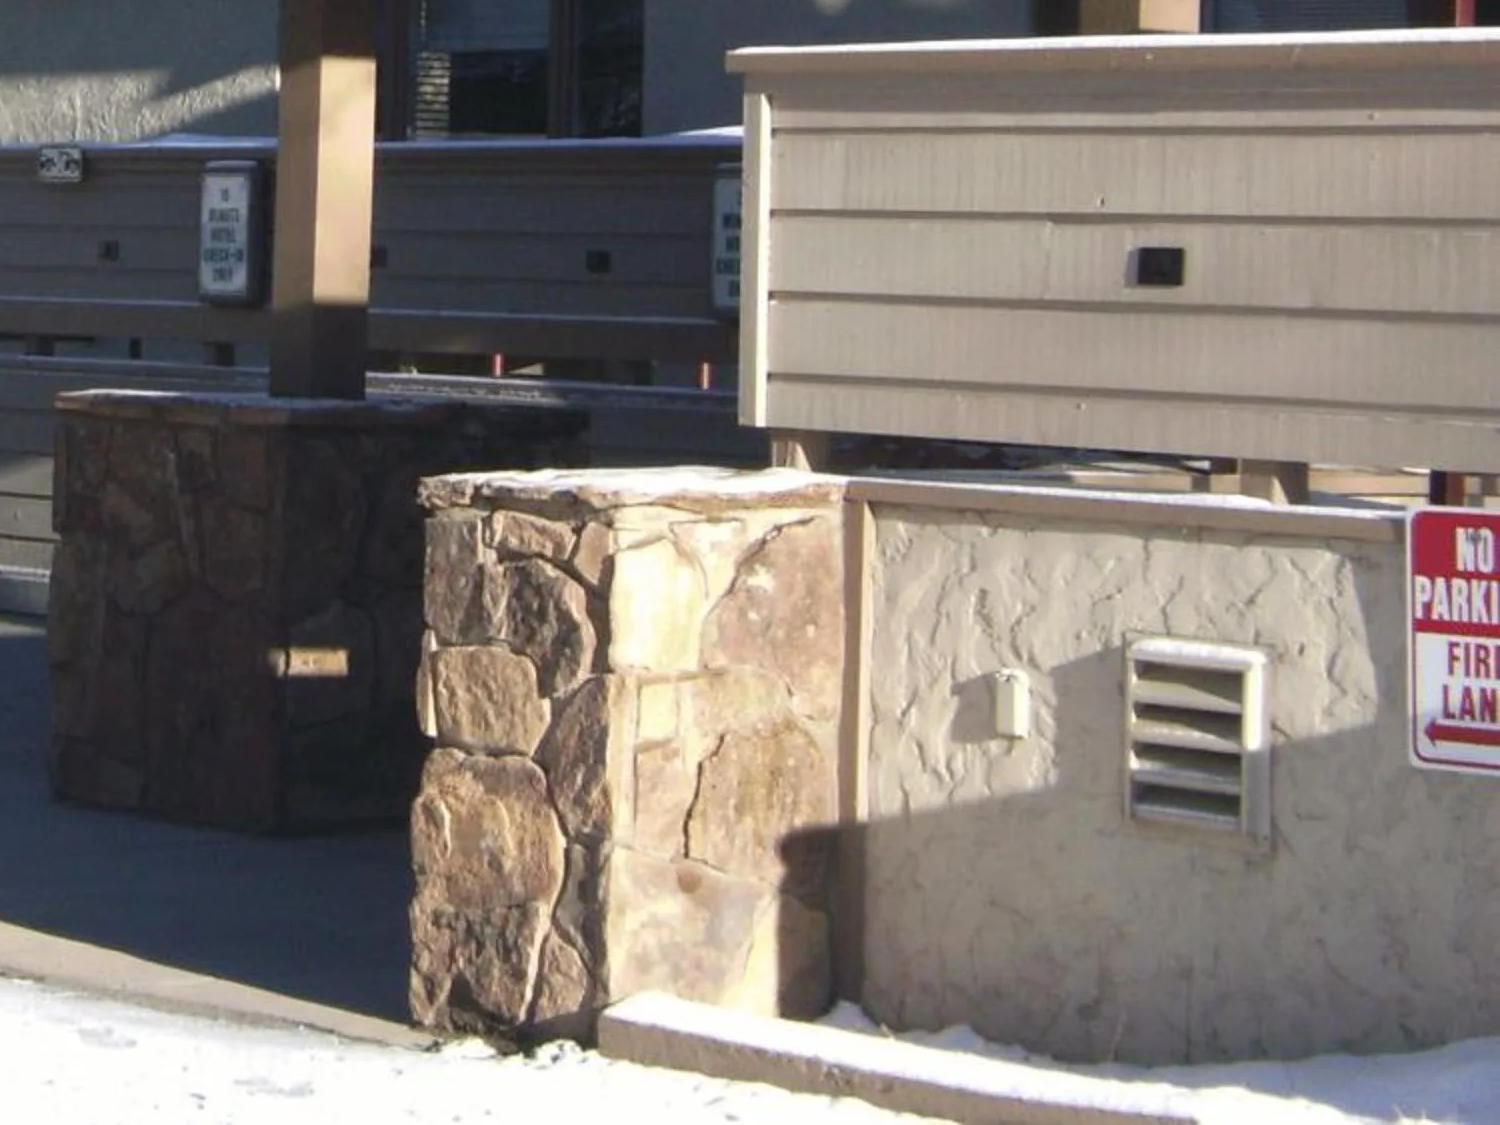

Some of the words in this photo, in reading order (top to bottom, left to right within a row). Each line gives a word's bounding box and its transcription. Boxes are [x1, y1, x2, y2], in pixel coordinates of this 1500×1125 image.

[1455, 527, 1495, 573] NO
[1414, 575, 1500, 625] PARKI
[1442, 684, 1497, 724] LAN
